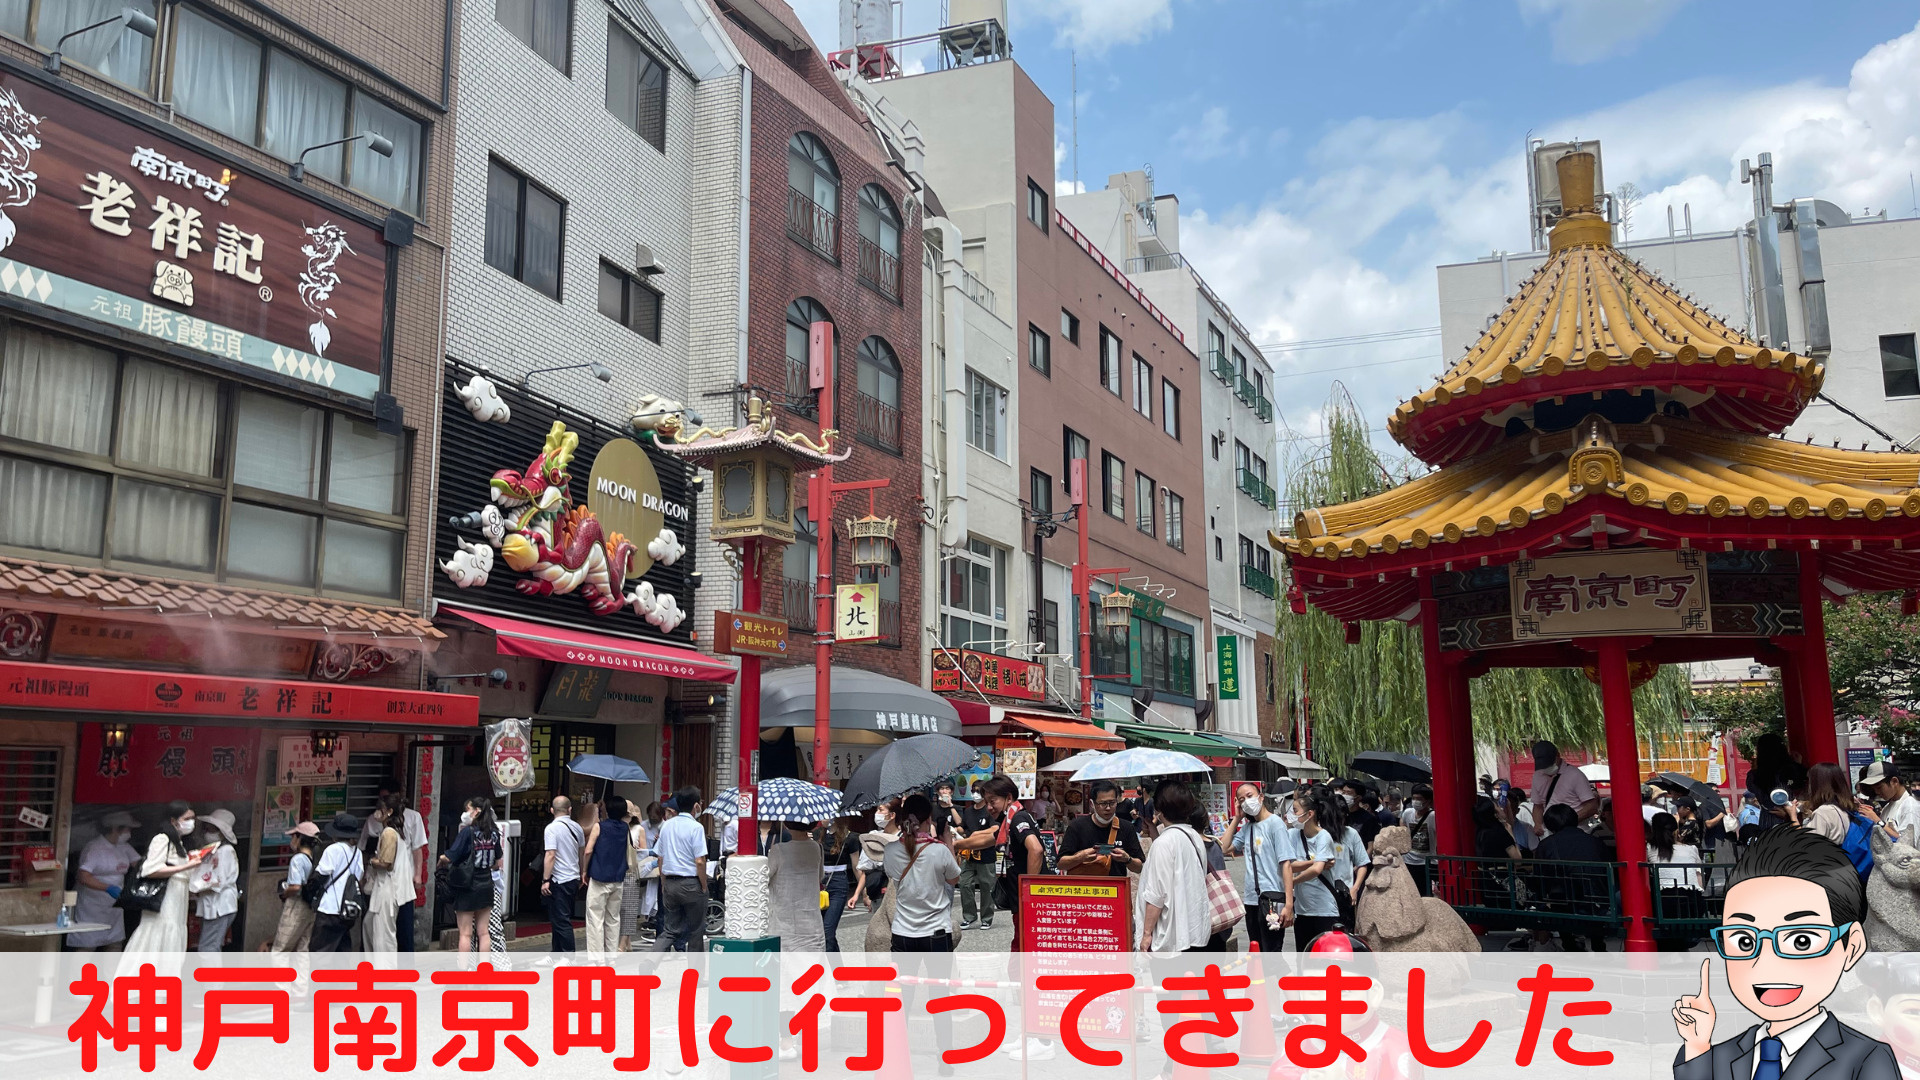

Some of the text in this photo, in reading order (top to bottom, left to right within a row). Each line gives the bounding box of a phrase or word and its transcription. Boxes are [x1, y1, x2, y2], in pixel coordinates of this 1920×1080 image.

[130, 145, 229, 202] 南京町
[77, 171, 264, 284] 老祥記
[90, 296, 245, 361] 元祖 豚饅頭
[596, 475, 690, 522] MOON DRAGON
[1523, 572, 1697, 616] 南京町
[845, 605, 869, 626] 北
[744, 621, 784, 636] 観光トイレ
[600, 655, 670, 673] MOON DRAGON
[984, 658, 998, 674] 中華
[1223, 643, 1233, 675] 上海料理
[238, 685, 332, 715] 老祥記
[387, 699, 446, 716] 創業大正四年
[158, 726, 194, 741] 元祖
[1038, 886, 1110, 896] 南京町内禁止事項
